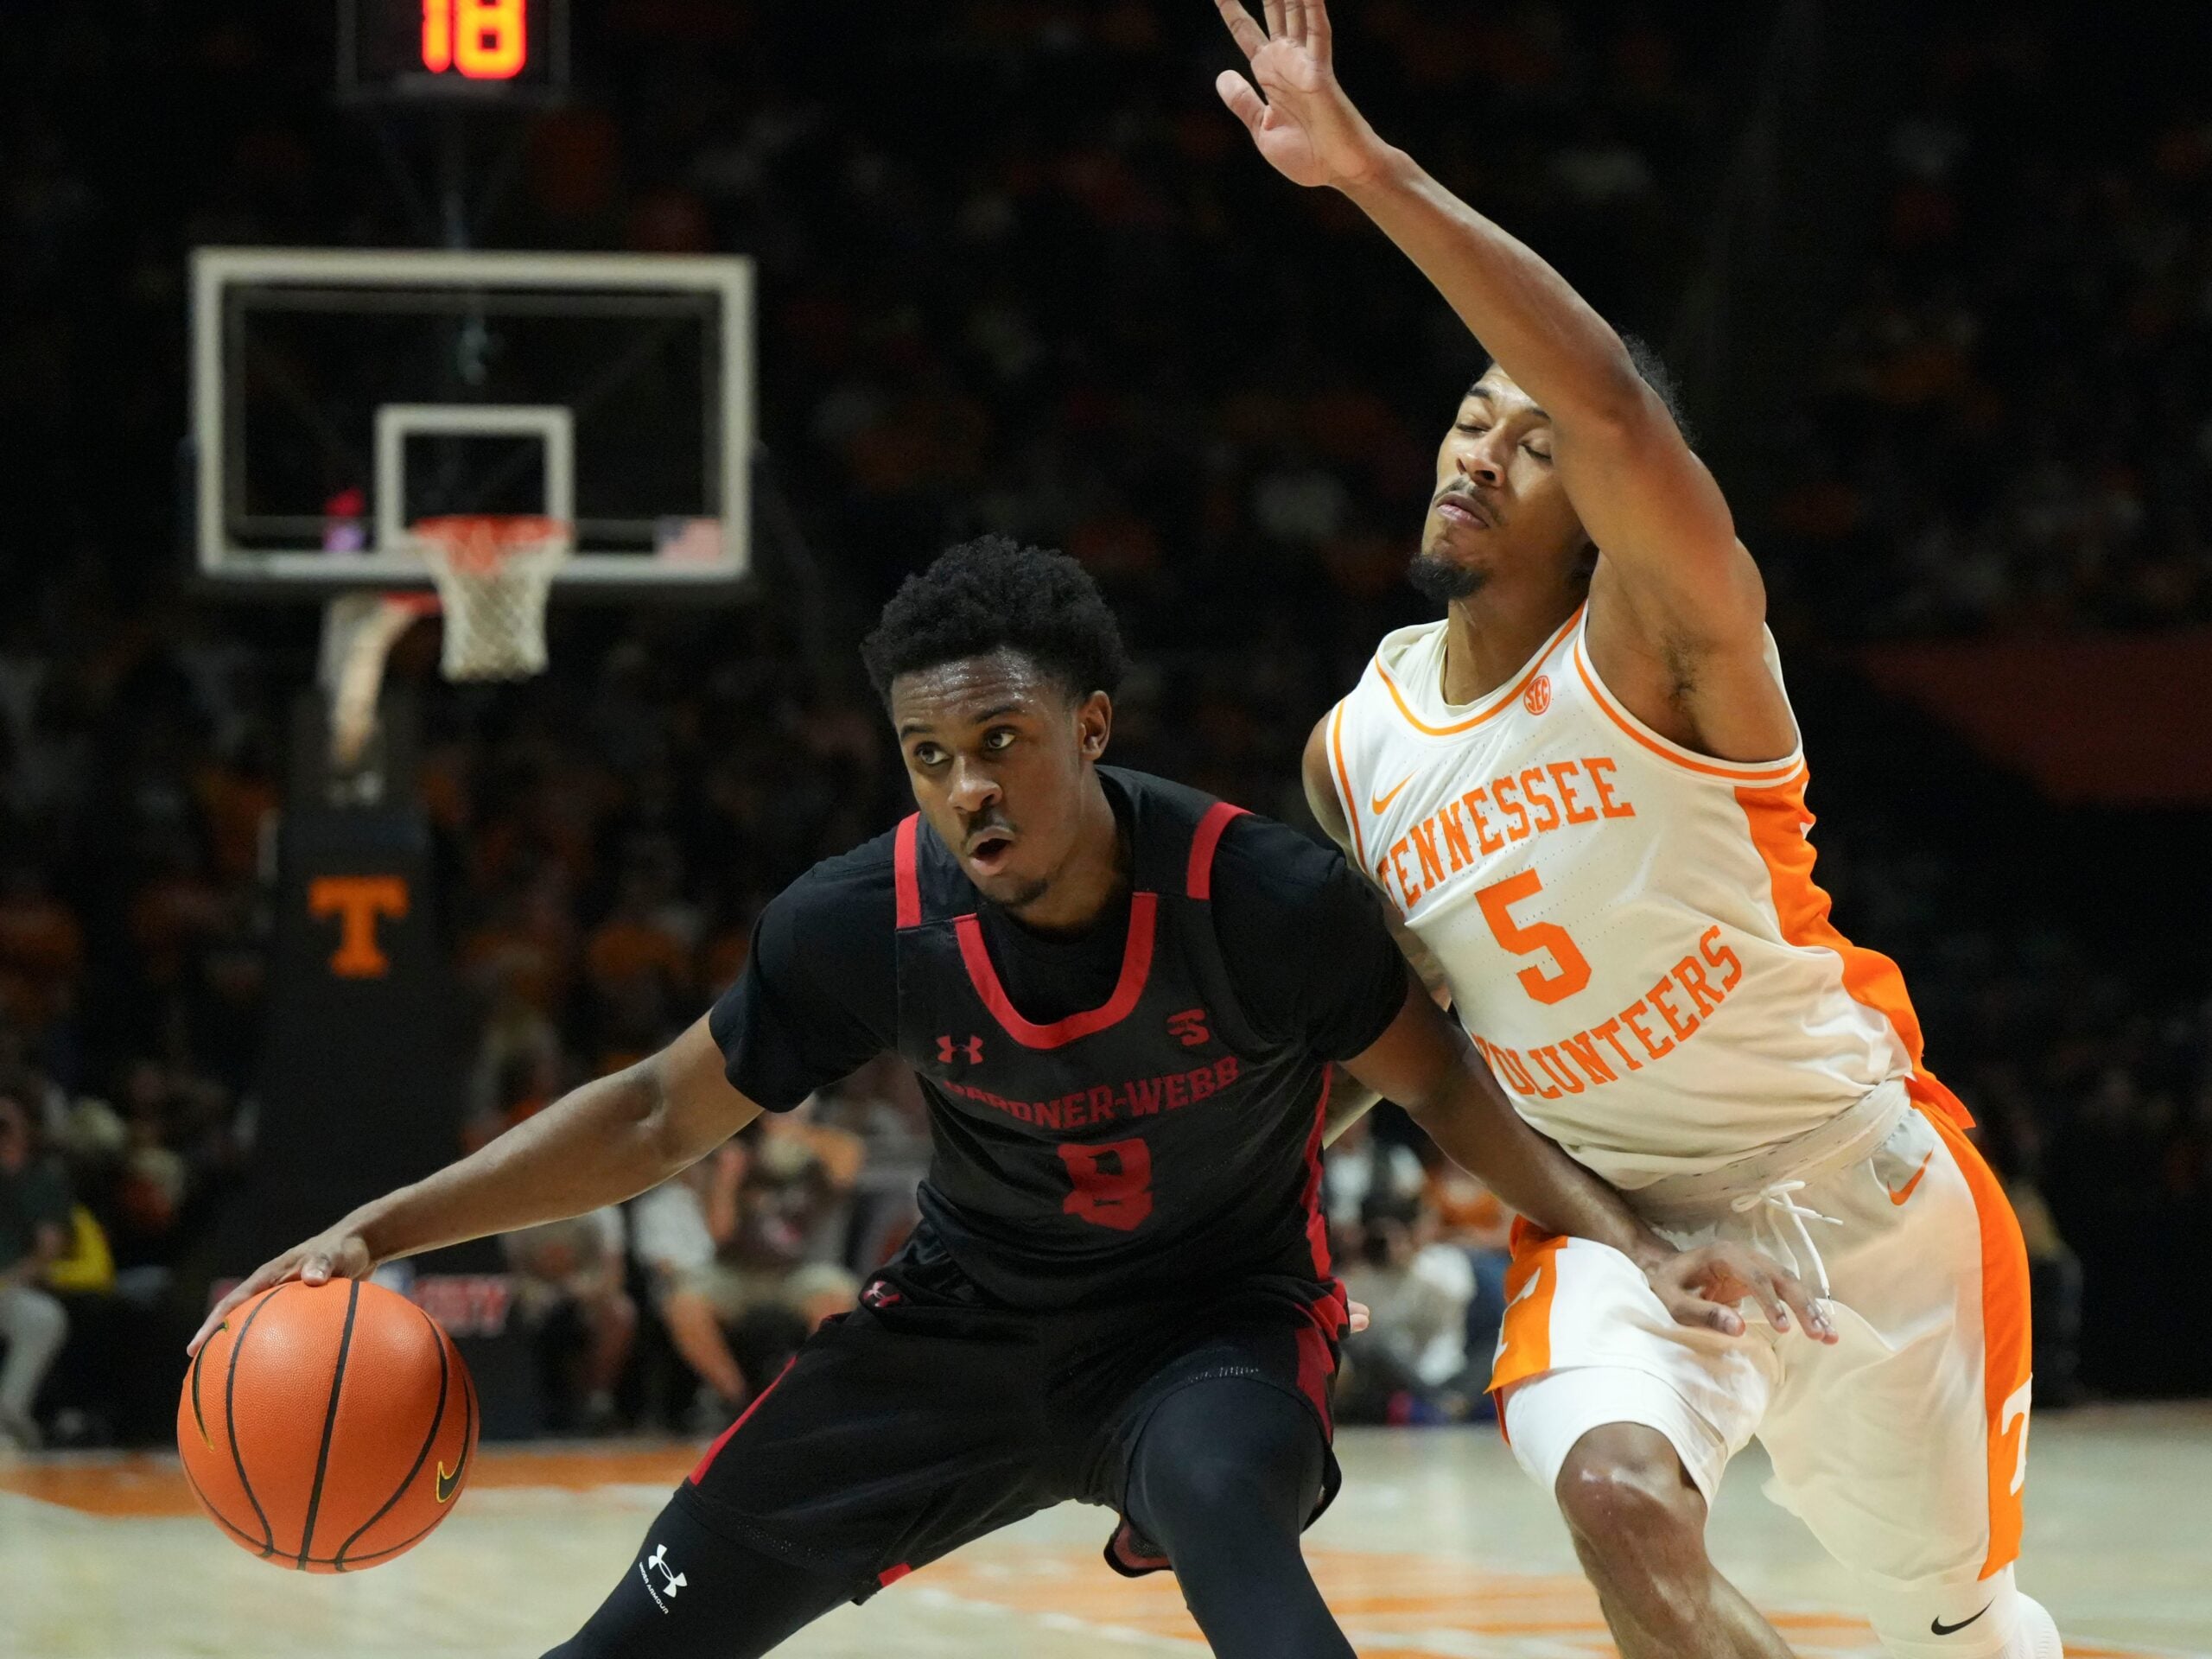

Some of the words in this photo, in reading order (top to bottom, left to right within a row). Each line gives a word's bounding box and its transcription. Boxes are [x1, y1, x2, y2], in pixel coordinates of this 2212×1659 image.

[422, 0, 526, 79] 18
[1525, 677, 1549, 713] SEC
[1376, 757, 1636, 912] TENNESSEE
[309, 875, 410, 976] T
[1474, 868, 1592, 1005] 5
[646, 1585, 669, 1614] ARMOUR
